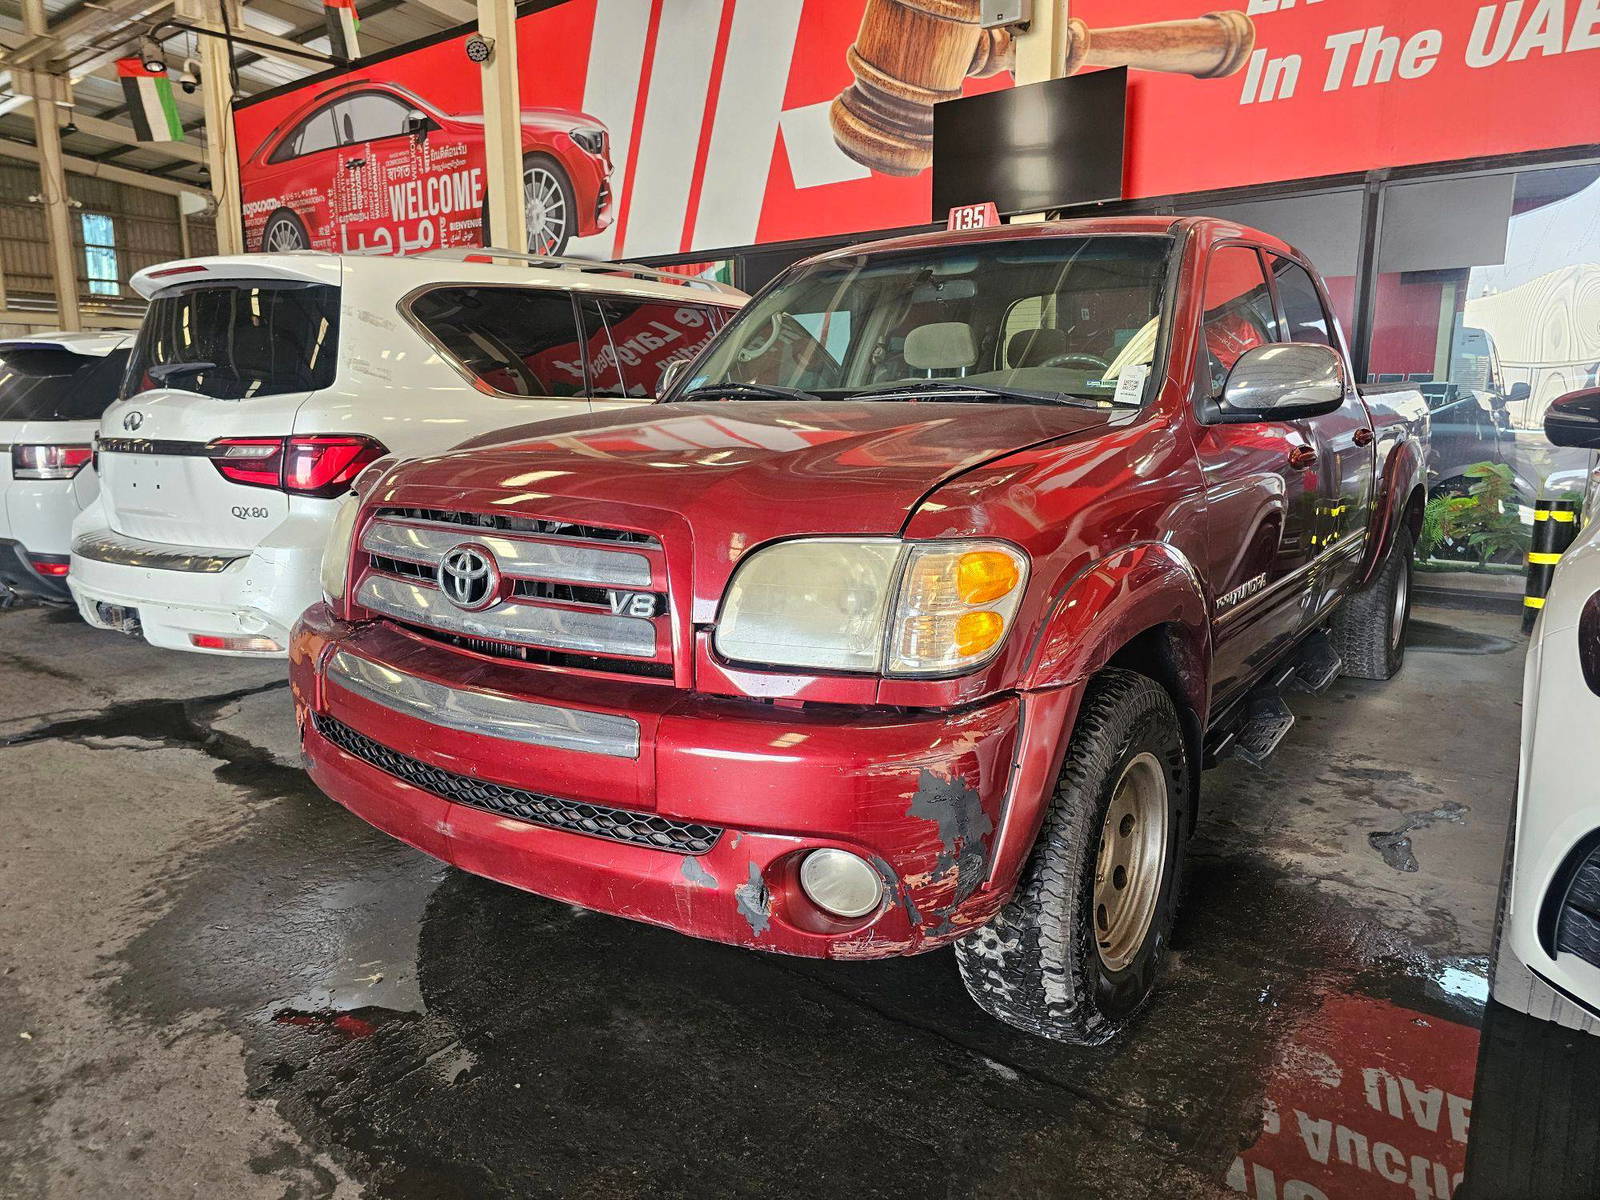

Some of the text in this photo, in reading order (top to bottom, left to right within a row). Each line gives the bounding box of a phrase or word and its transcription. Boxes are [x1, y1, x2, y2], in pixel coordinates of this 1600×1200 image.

[1239, 48, 1302, 105] In
[1323, 25, 1443, 92] The
[388, 167, 483, 222] WELCOME
[954, 205, 984, 231] 135
[341, 217, 435, 256] مرحبا
[231, 505, 269, 521] QX80
[608, 589, 657, 619] V8
